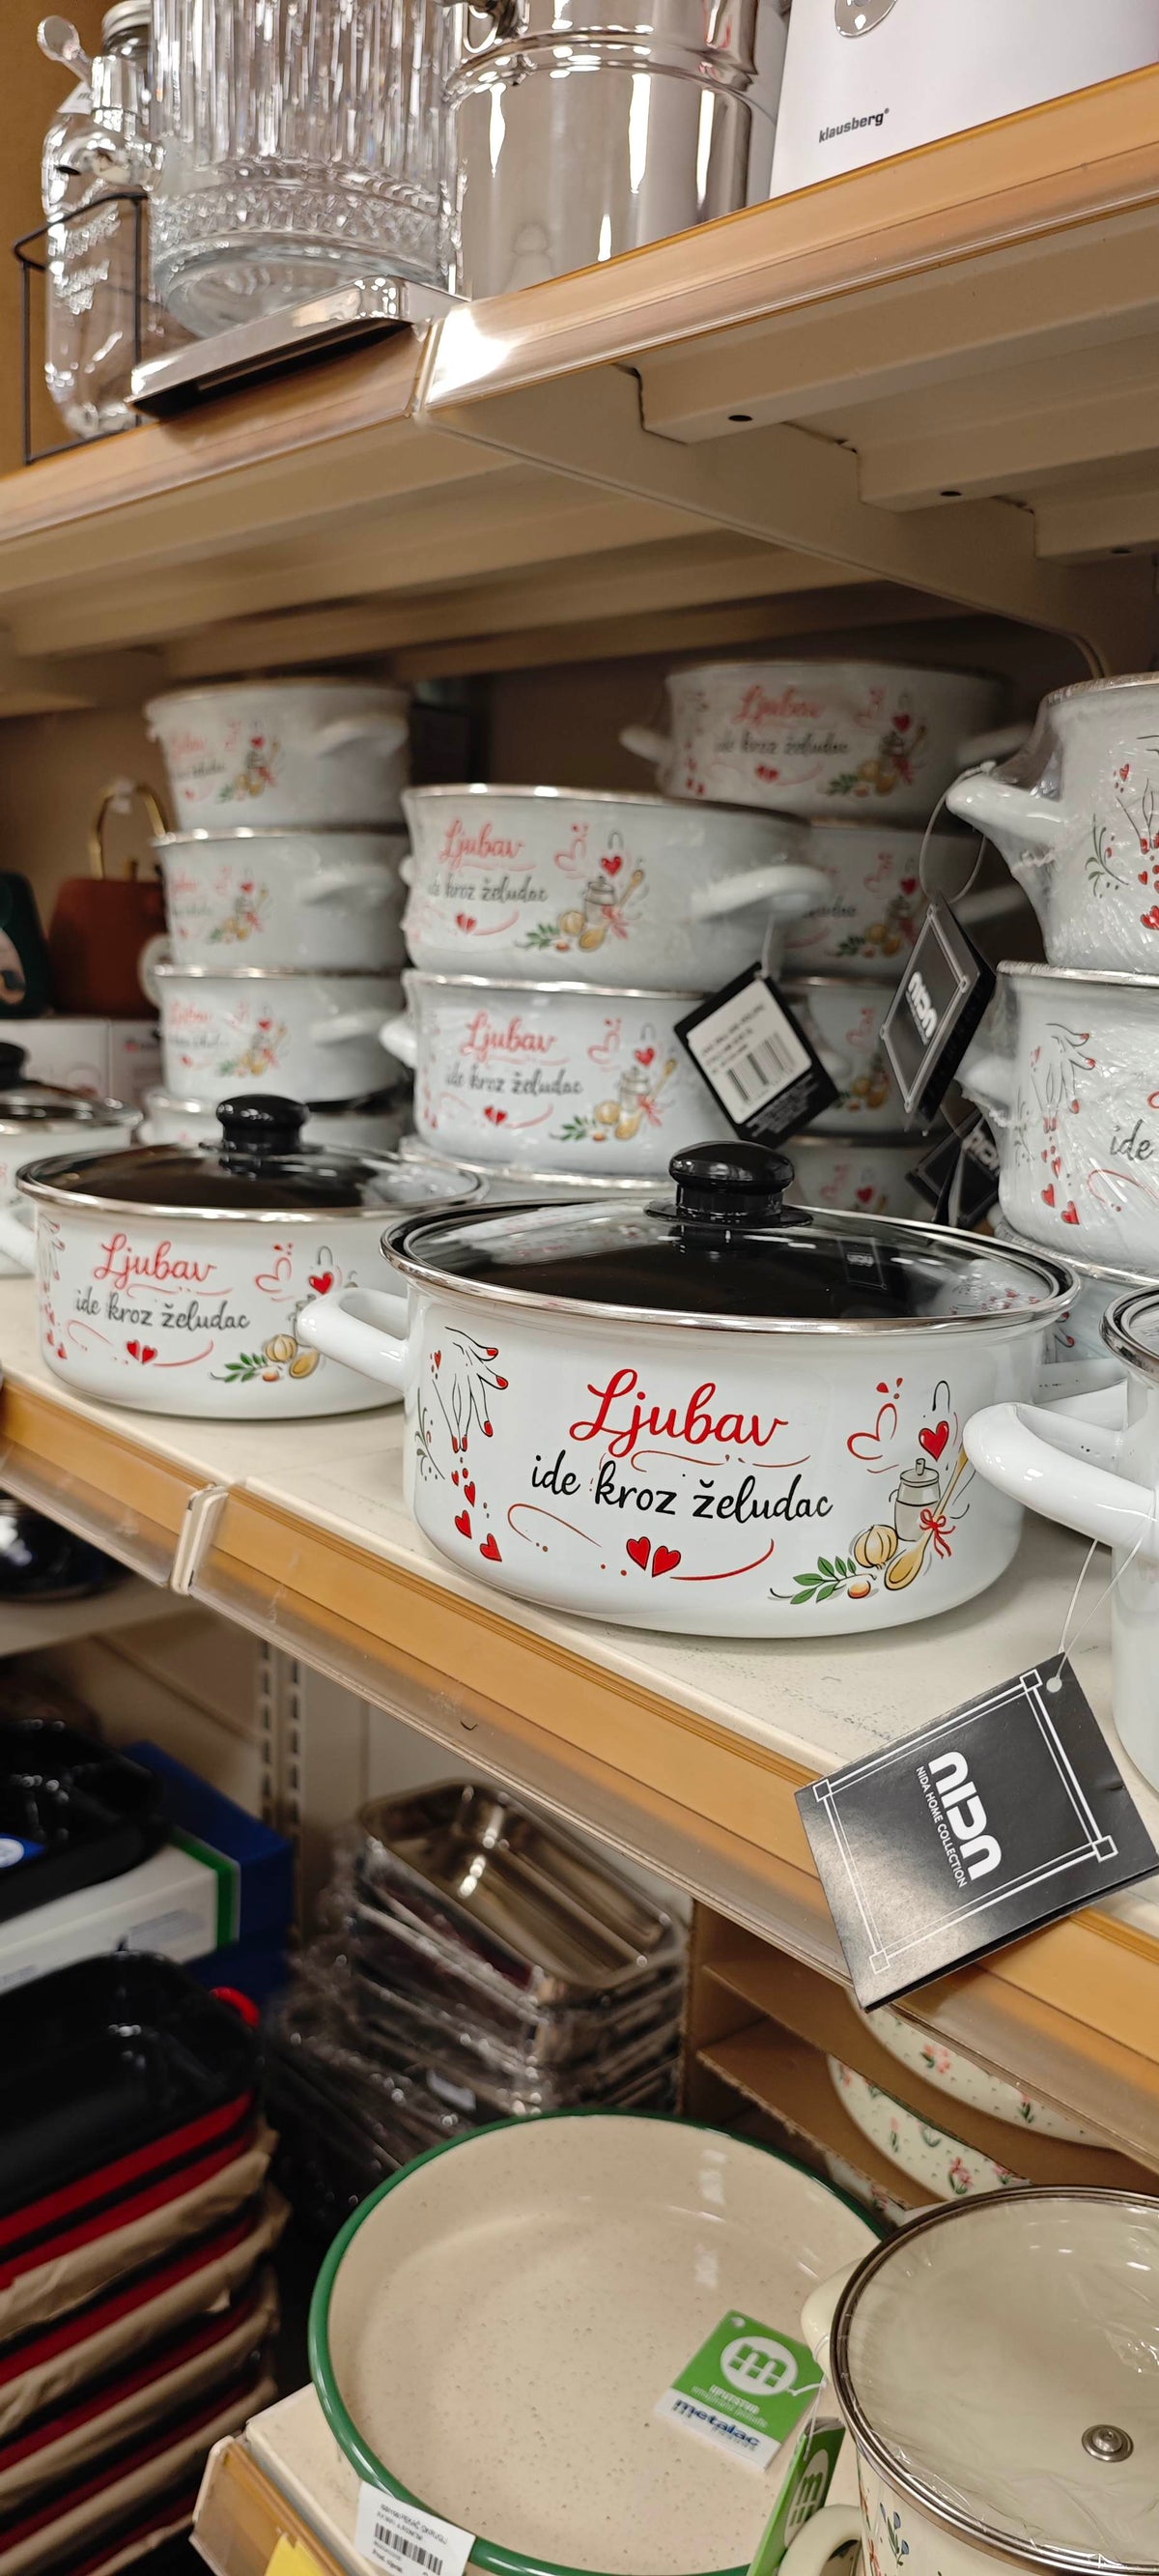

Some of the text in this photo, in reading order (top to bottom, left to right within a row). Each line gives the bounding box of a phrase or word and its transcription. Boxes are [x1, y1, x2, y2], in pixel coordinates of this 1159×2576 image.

[438, 816, 525, 872] Ljubav
[445, 873, 476, 901] kroz
[481, 874, 549, 904] želudac
[461, 1010, 558, 1065] Ljubav
[470, 1064, 505, 1093] kroz
[511, 1069, 584, 1098] želudac
[1109, 1118, 1154, 1161] ide
[94, 1232, 217, 1291] Ljubav
[75, 1285, 252, 1332] ide kroz želudac
[568, 1367, 790, 1459] Ljubav
[530, 1448, 834, 1525] ide kroz želudac
[916, 1765, 968, 1889] NIDA HOME COLLECTION
[672, 2398, 761, 2449] metalac
